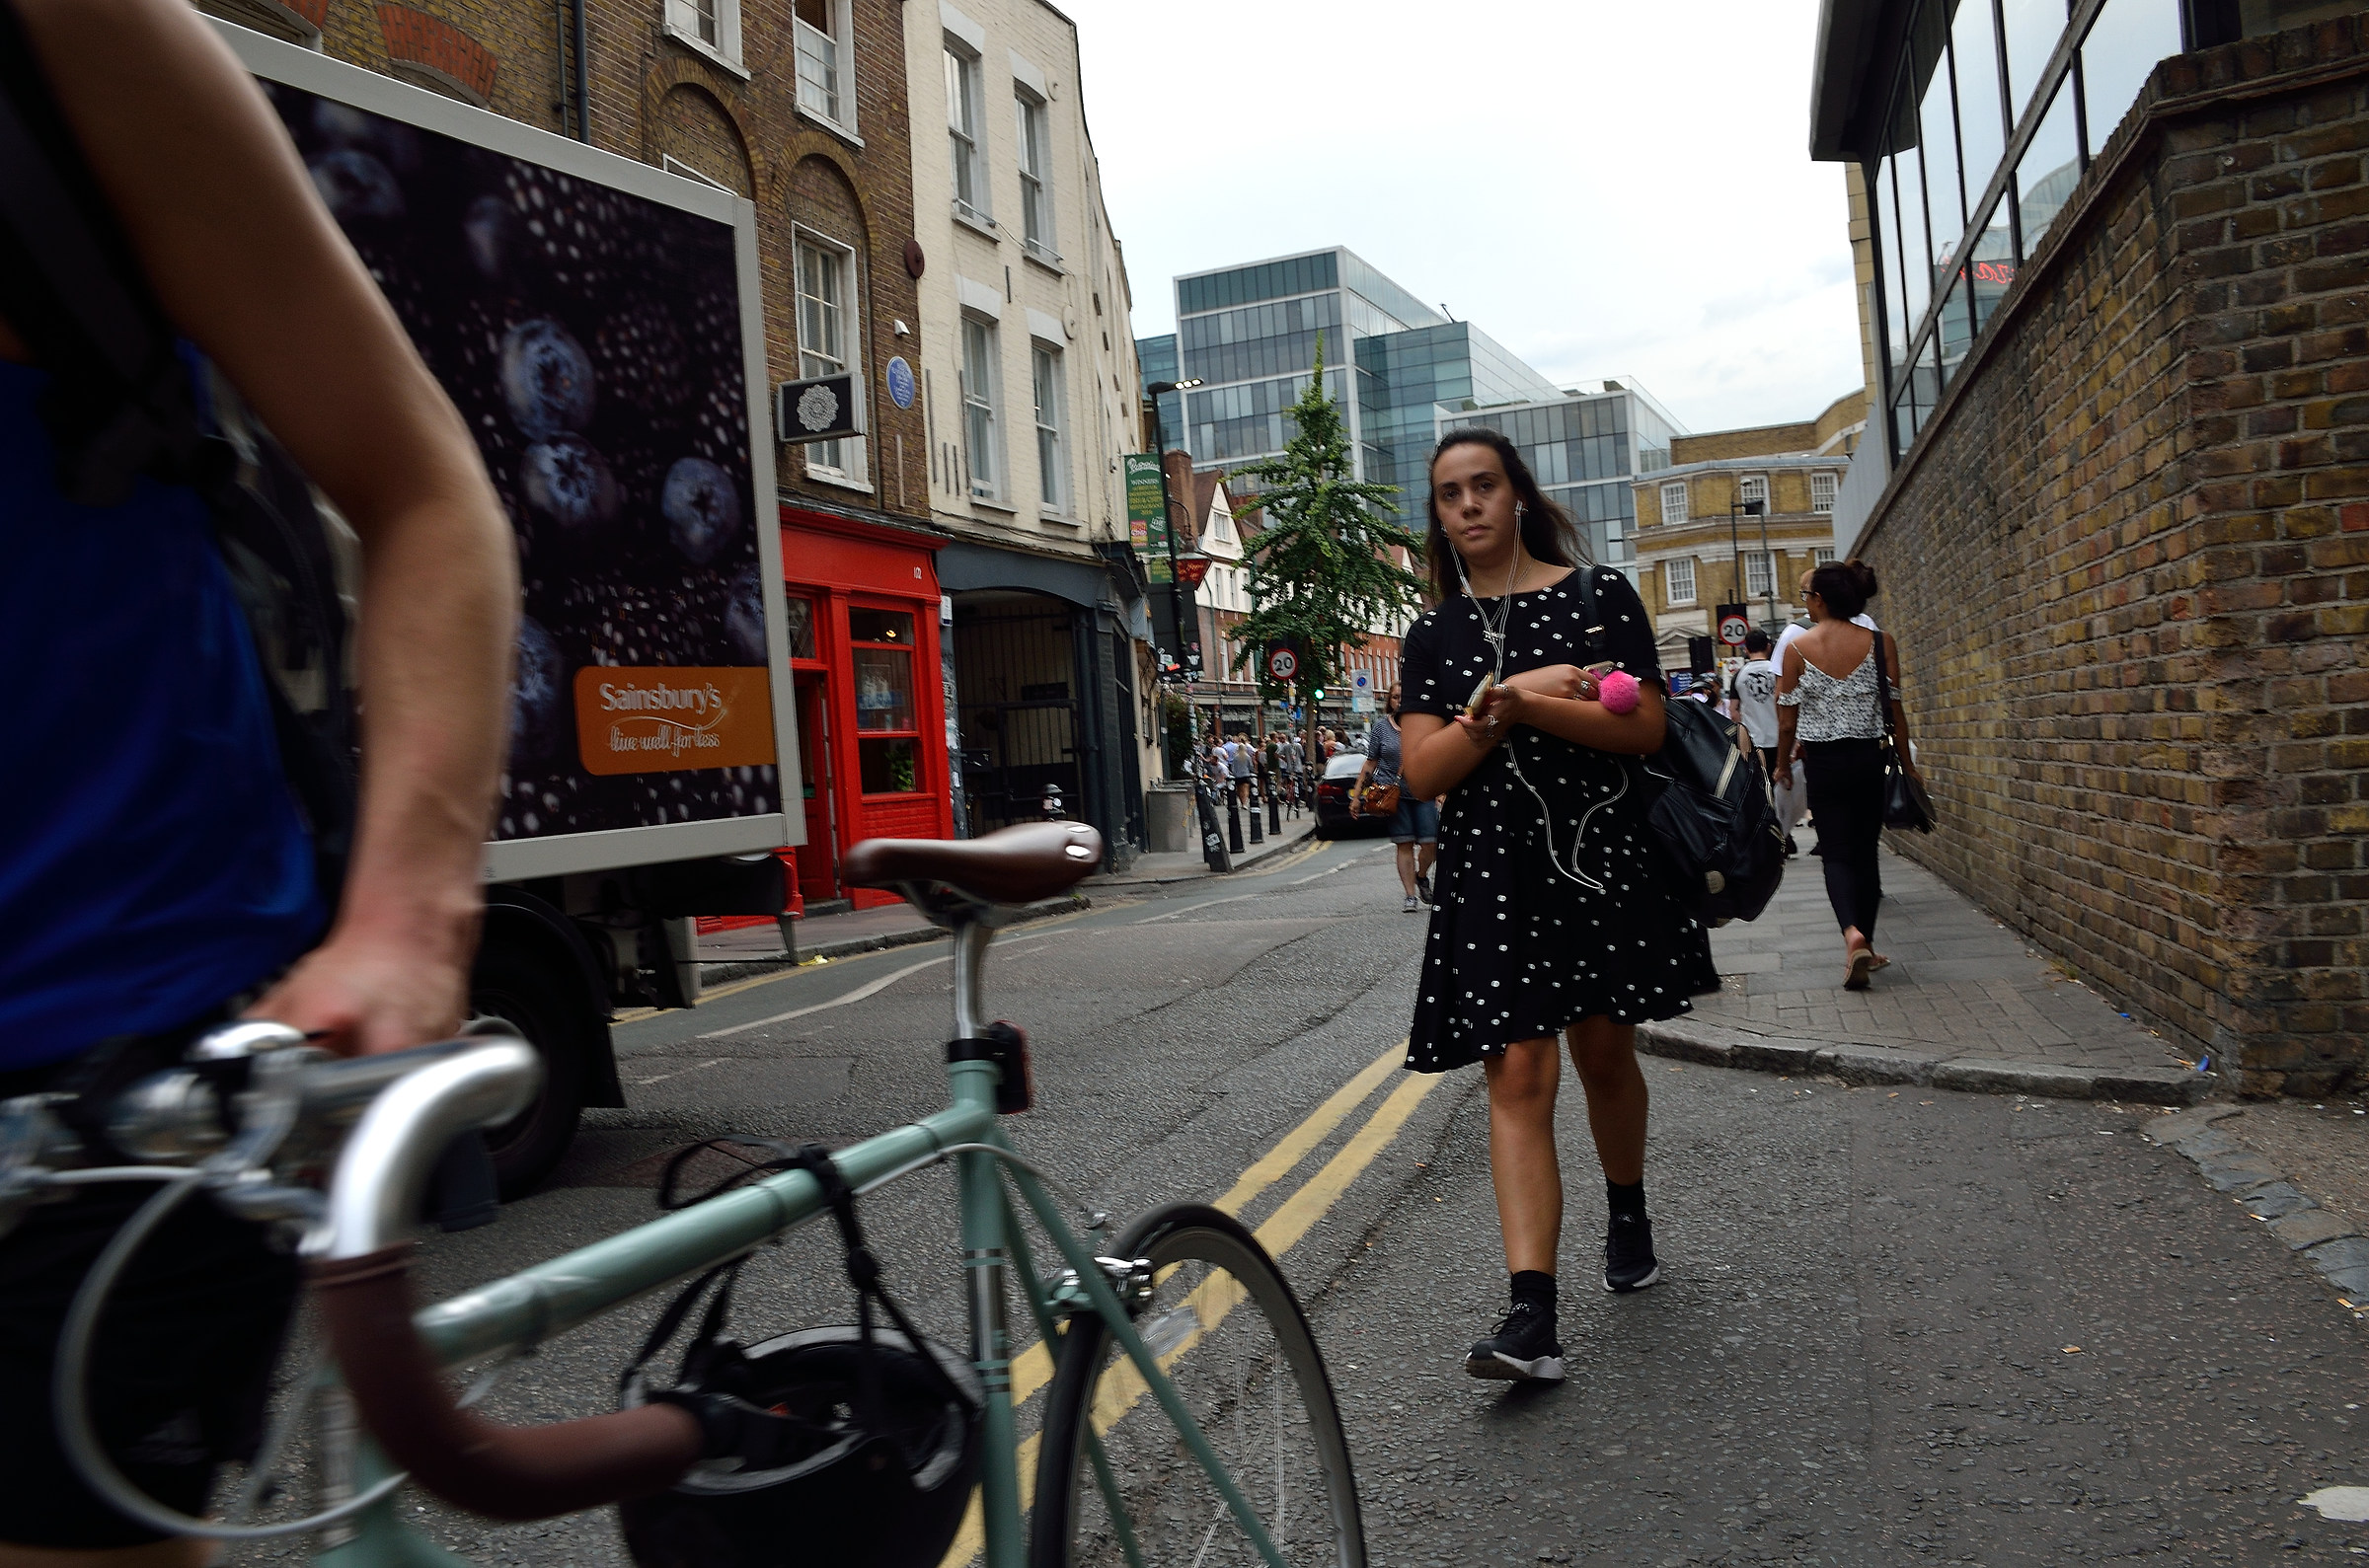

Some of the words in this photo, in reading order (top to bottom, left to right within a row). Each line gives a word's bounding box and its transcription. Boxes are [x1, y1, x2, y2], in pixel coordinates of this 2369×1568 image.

[1723, 624, 1746, 637] 20
[1274, 656, 1293, 672] 20
[599, 682, 722, 715] Sainsbury's
[610, 725, 637, 752] live
[639, 724, 671, 751] well
[671, 726, 692, 758] for
[693, 723, 720, 748] less
